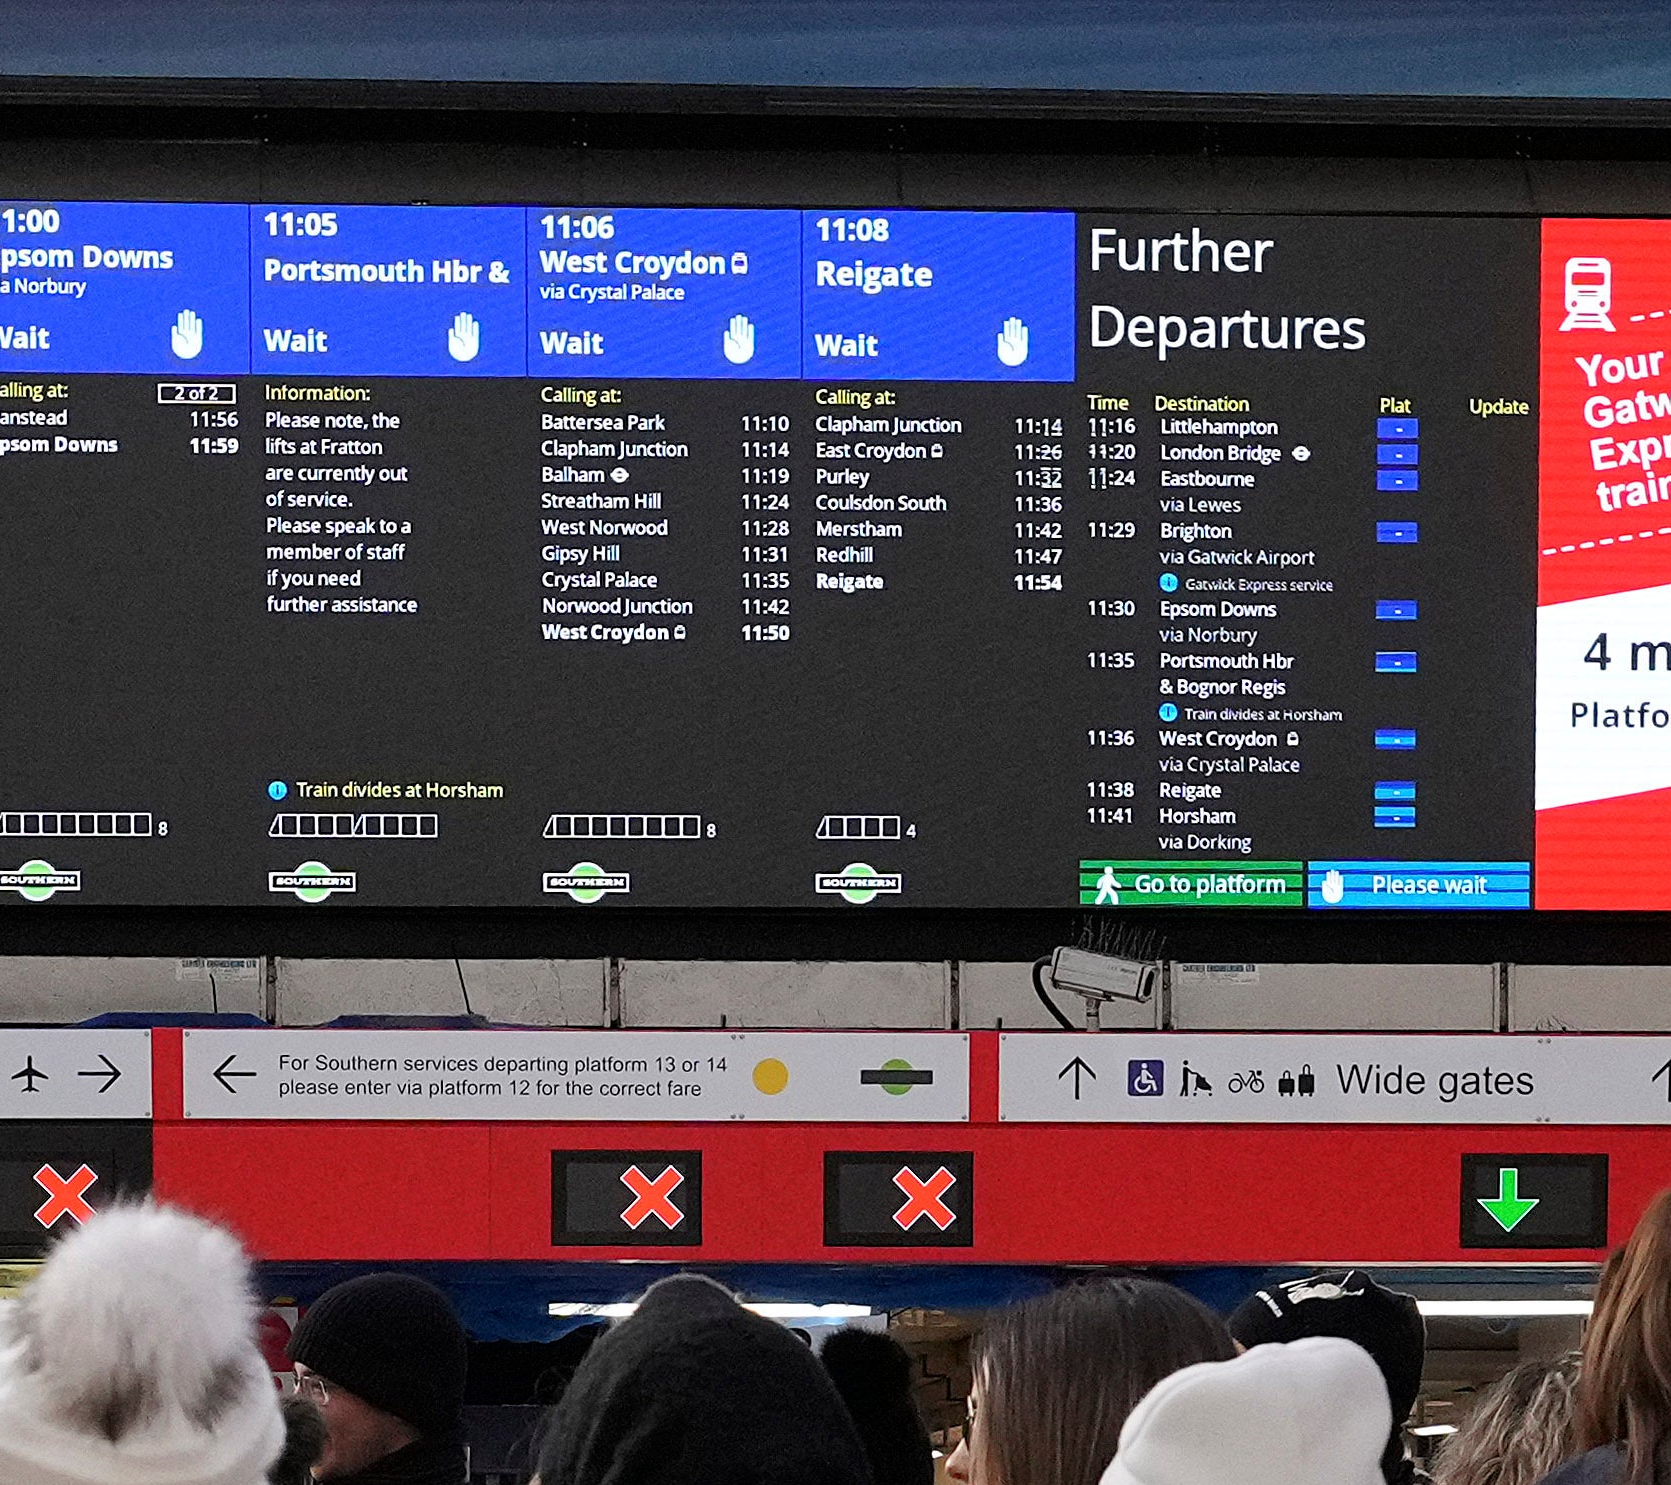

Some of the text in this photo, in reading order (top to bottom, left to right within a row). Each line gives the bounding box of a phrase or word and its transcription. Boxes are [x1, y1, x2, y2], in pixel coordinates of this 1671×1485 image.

[264, 211, 338, 237] 11:05
[541, 214, 615, 240] 11:06
[816, 217, 889, 242] 11:08
[82, 244, 174, 269] Downs
[1091, 227, 1275, 273] Further
[264, 258, 510, 284] Portsmouth Hbr &
[539, 249, 726, 281] West Croydon
[816, 259, 933, 295] Reigate
[14, 276, 87, 299] Norbury
[539, 282, 685, 304] via Crystal Palace
[263, 328, 328, 353] Wait
[539, 330, 604, 355] Wait
[814, 333, 879, 357] Wait
[1091, 305, 1366, 362] Departures
[1574, 350, 1664, 387] Your
[1583, 632, 1612, 671] 4
[279, 1054, 727, 1077] For Southern services departing platform 13 or 14
[1336, 1063, 1534, 1103] Wide gates
